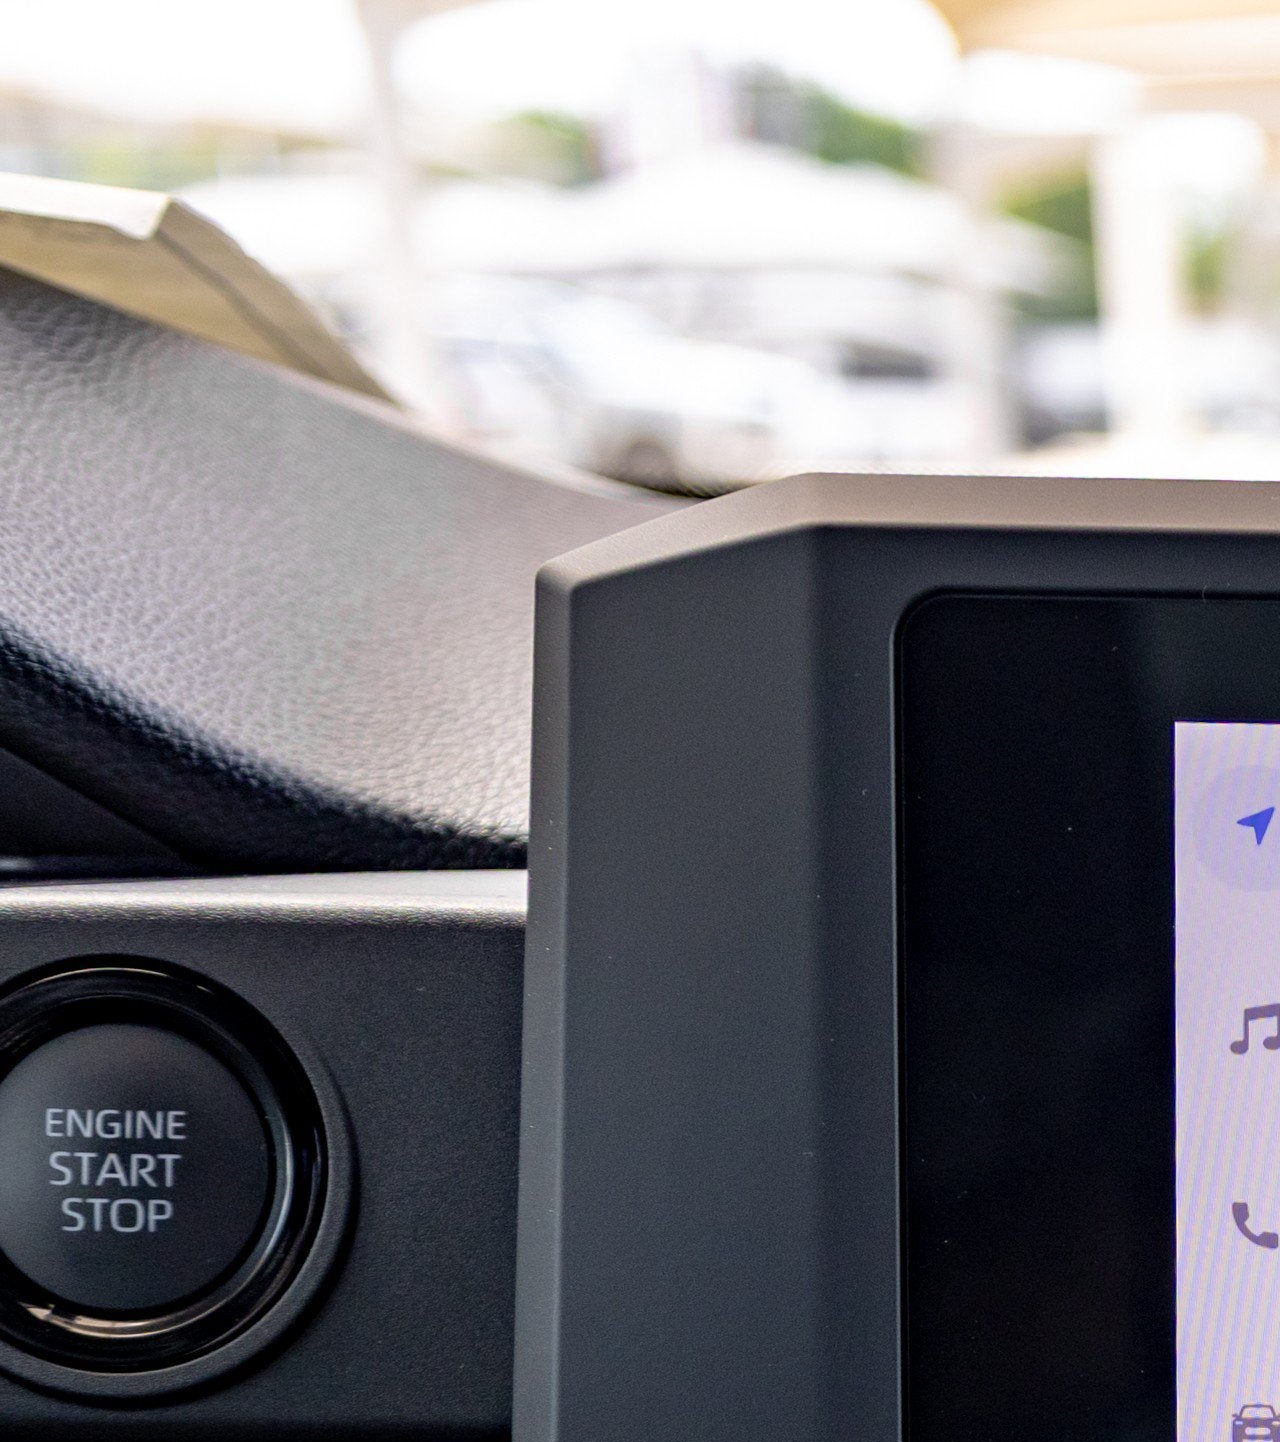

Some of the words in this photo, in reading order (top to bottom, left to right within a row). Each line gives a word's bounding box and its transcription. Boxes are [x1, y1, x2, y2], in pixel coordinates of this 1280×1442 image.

[46, 1108, 187, 1140] ENGINE
[49, 1152, 181, 1187] START
[62, 1198, 173, 1232] STOP
